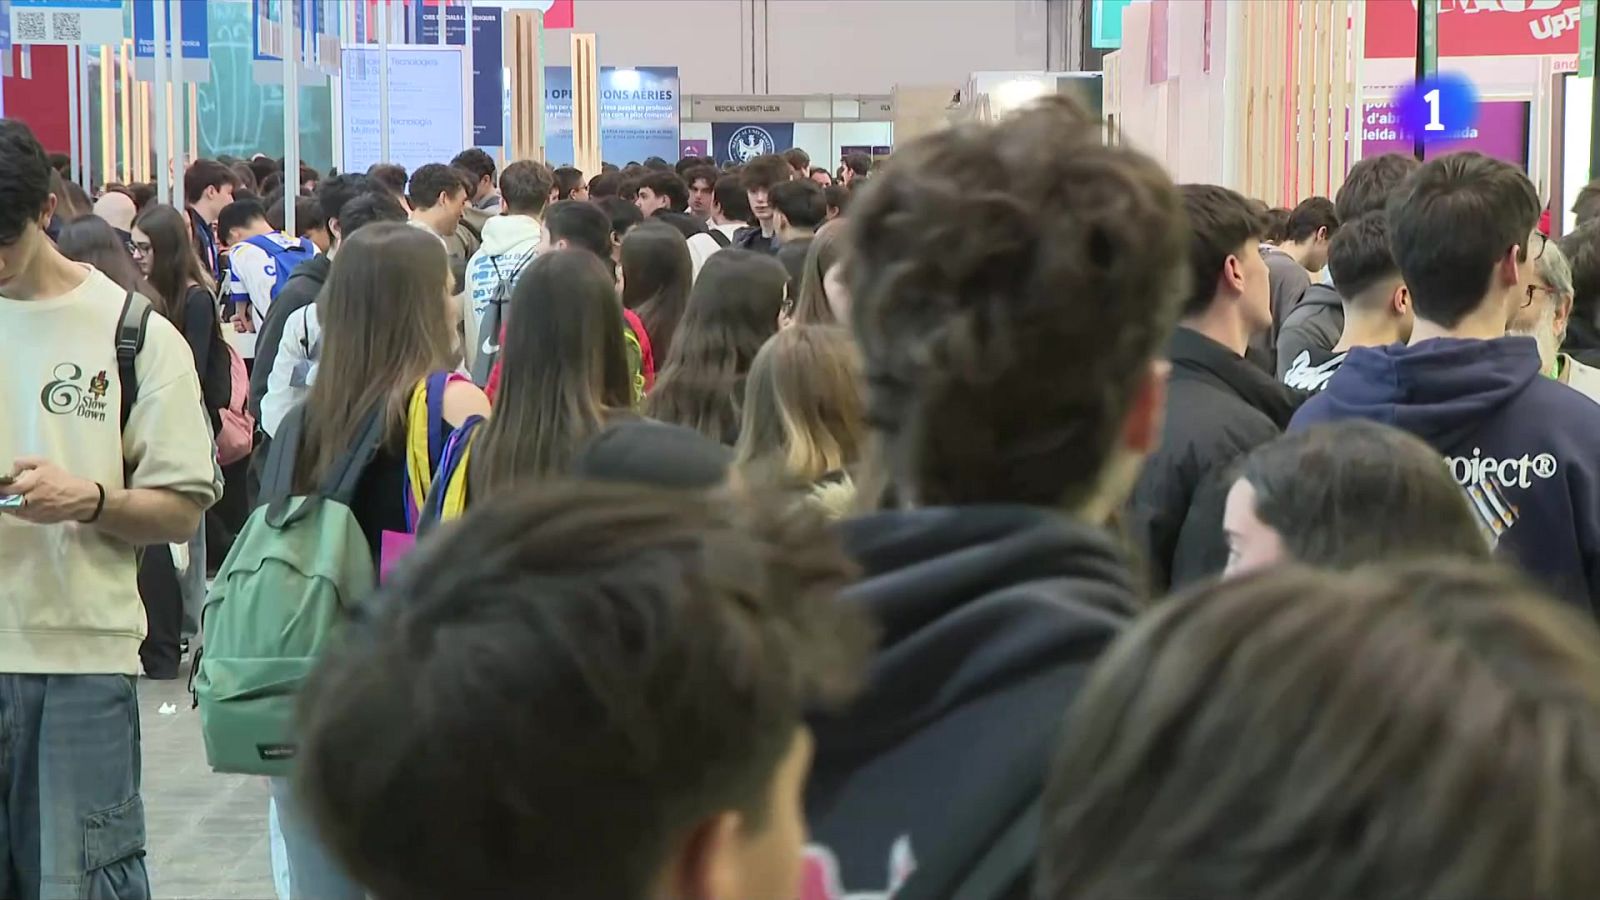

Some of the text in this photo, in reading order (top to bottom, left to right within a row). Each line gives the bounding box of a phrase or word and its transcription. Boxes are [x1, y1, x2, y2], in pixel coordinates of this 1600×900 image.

[1529, 7, 1580, 39] UPF
[1361, 128, 1396, 140] leida
[82, 396, 107, 410] Slow
[77, 405, 106, 421] Down
[1443, 447, 1557, 488] oject®
